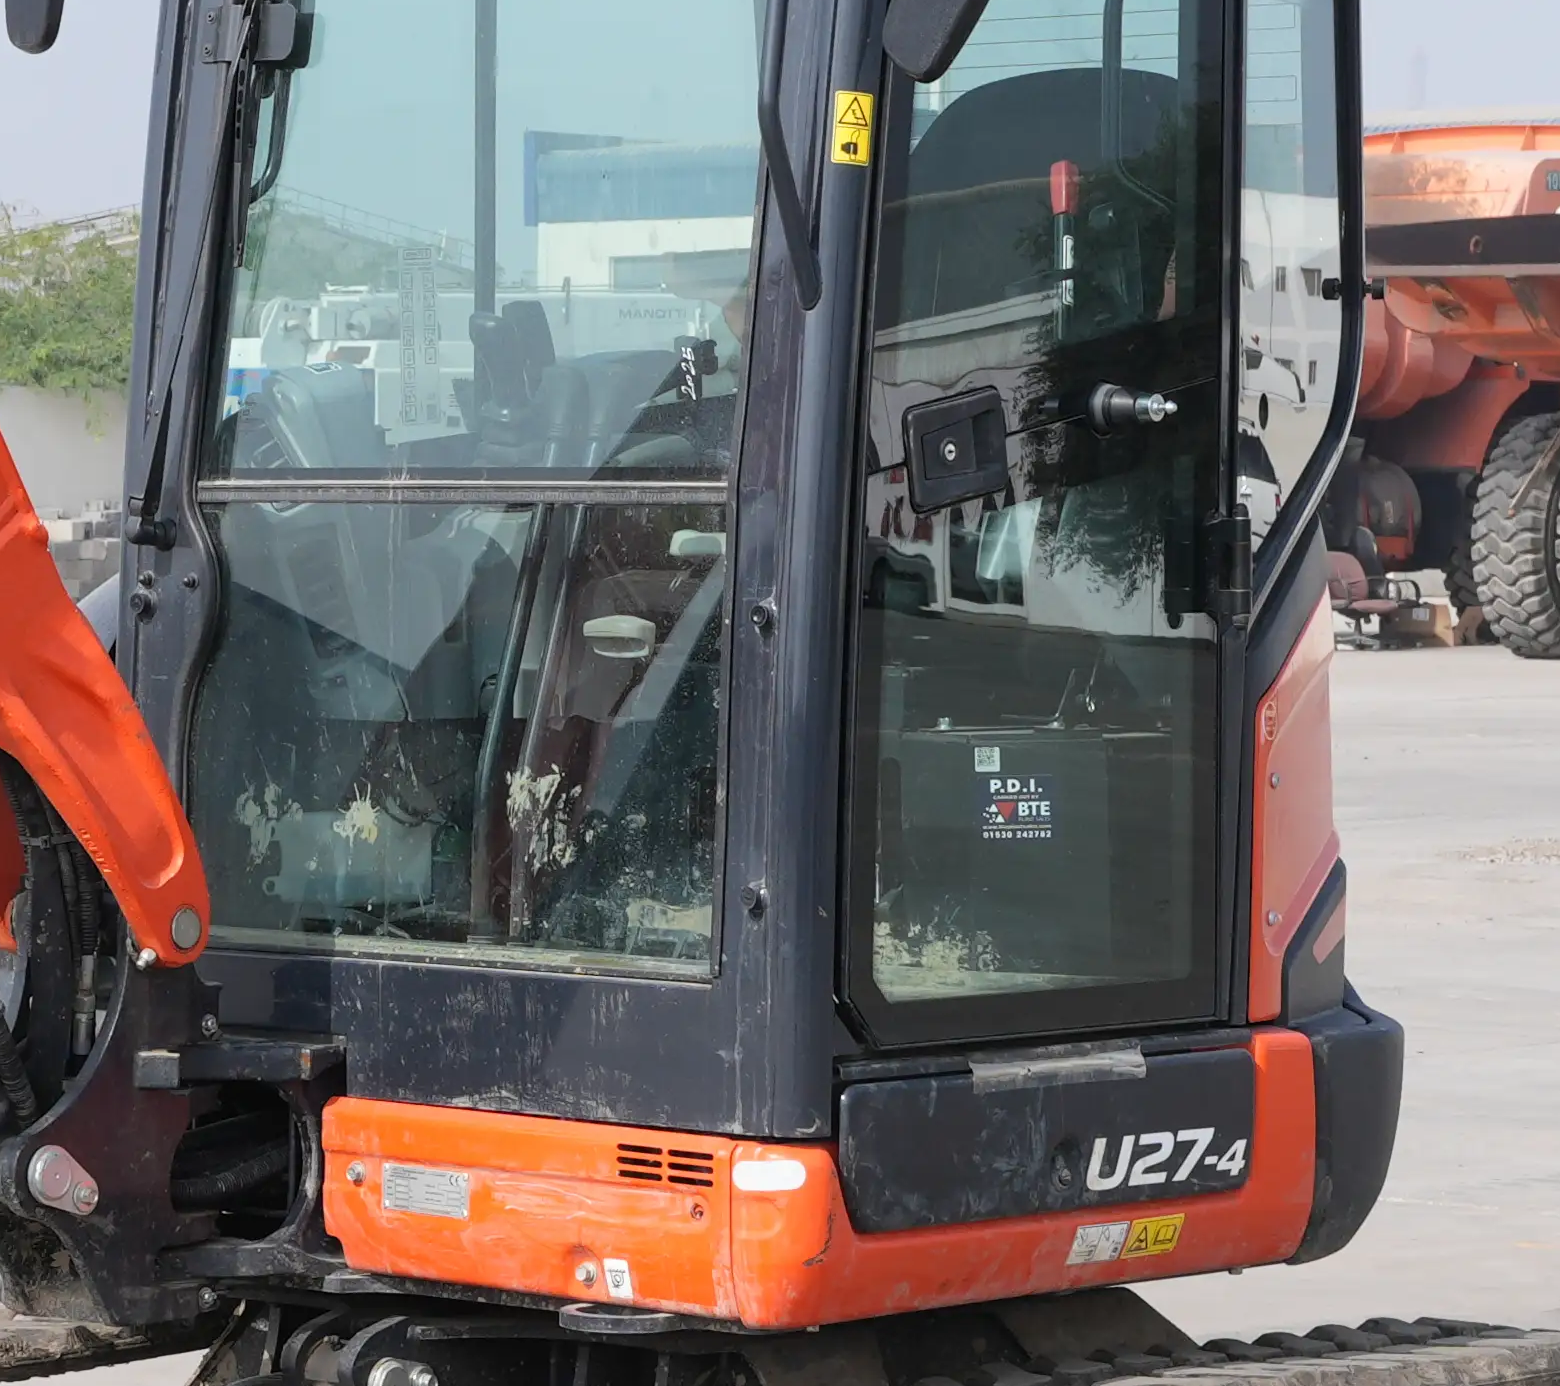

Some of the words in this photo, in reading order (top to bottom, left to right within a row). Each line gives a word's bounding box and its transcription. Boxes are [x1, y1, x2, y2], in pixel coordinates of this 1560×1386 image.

[989, 778, 1043, 794] P.D.I.
[1017, 801, 1051, 817] BTE
[1085, 1127, 1248, 1191] U27-4
